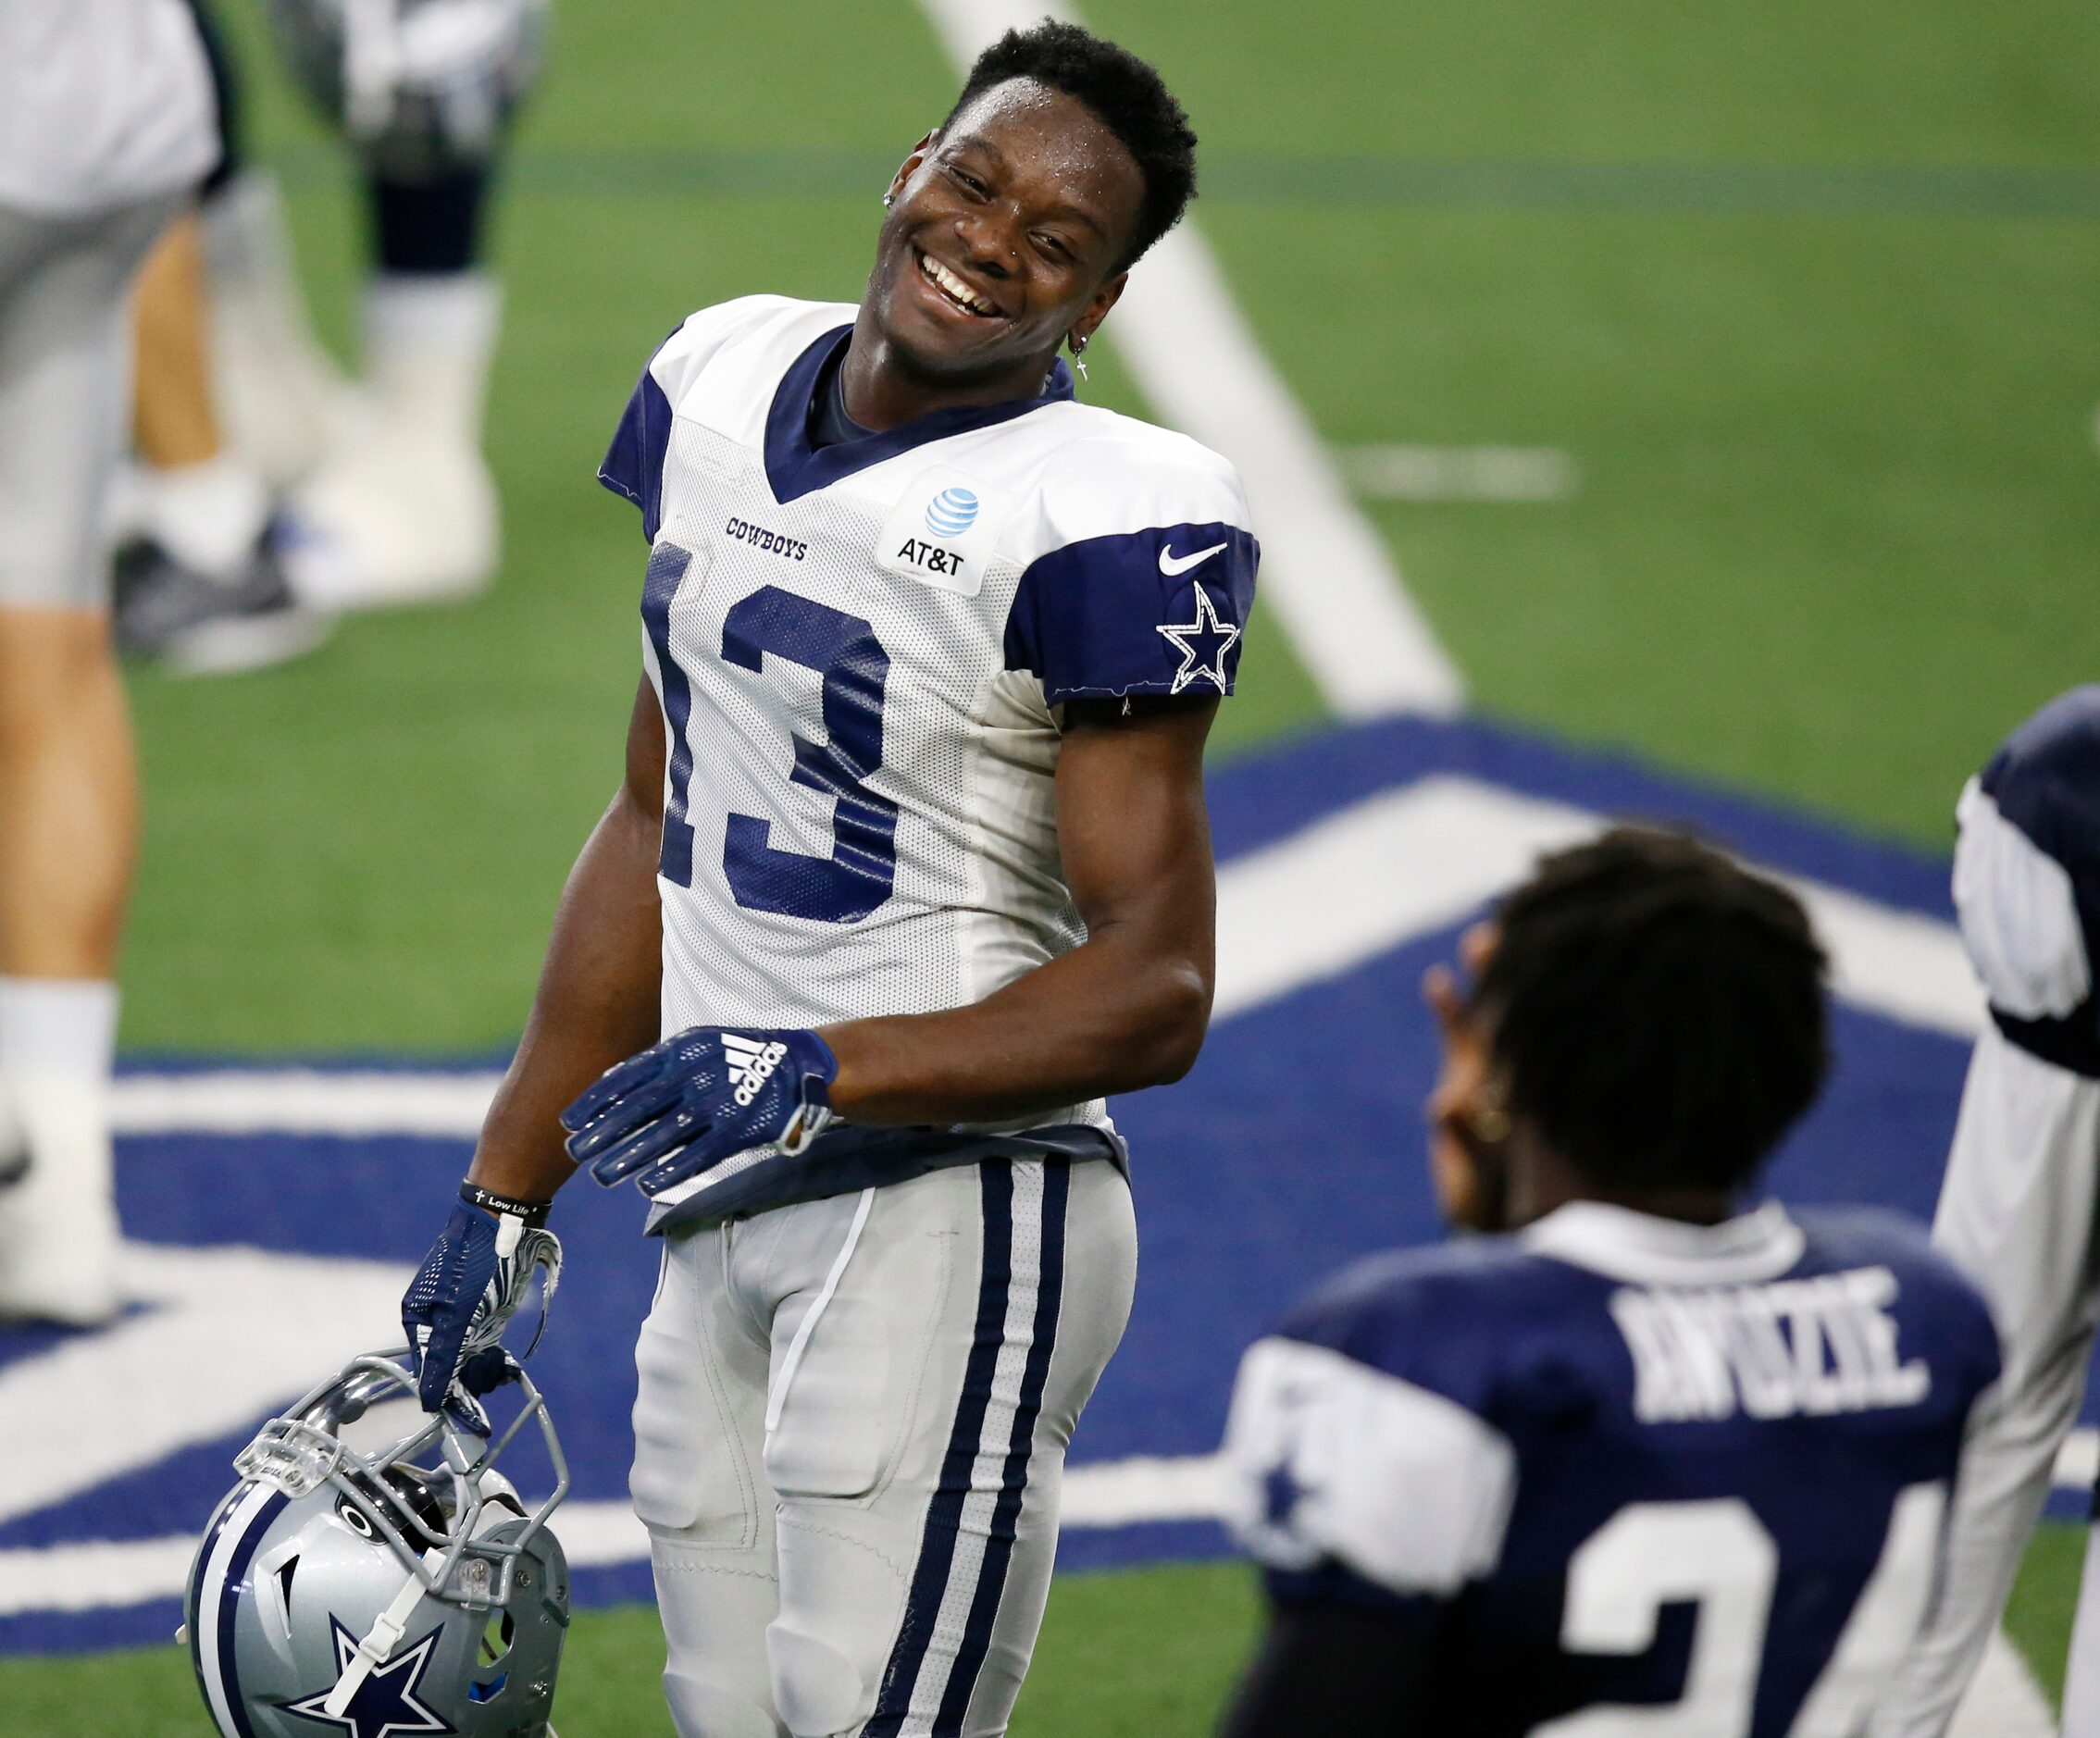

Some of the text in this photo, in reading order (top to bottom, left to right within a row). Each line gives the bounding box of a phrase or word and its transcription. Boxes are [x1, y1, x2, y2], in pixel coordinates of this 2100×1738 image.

[727, 517, 808, 561] COWBOYS
[897, 538, 964, 576] AT&T
[640, 540, 899, 925] 13
[734, 1041, 788, 1107] adidas
[488, 1197, 529, 1215] Low Life
